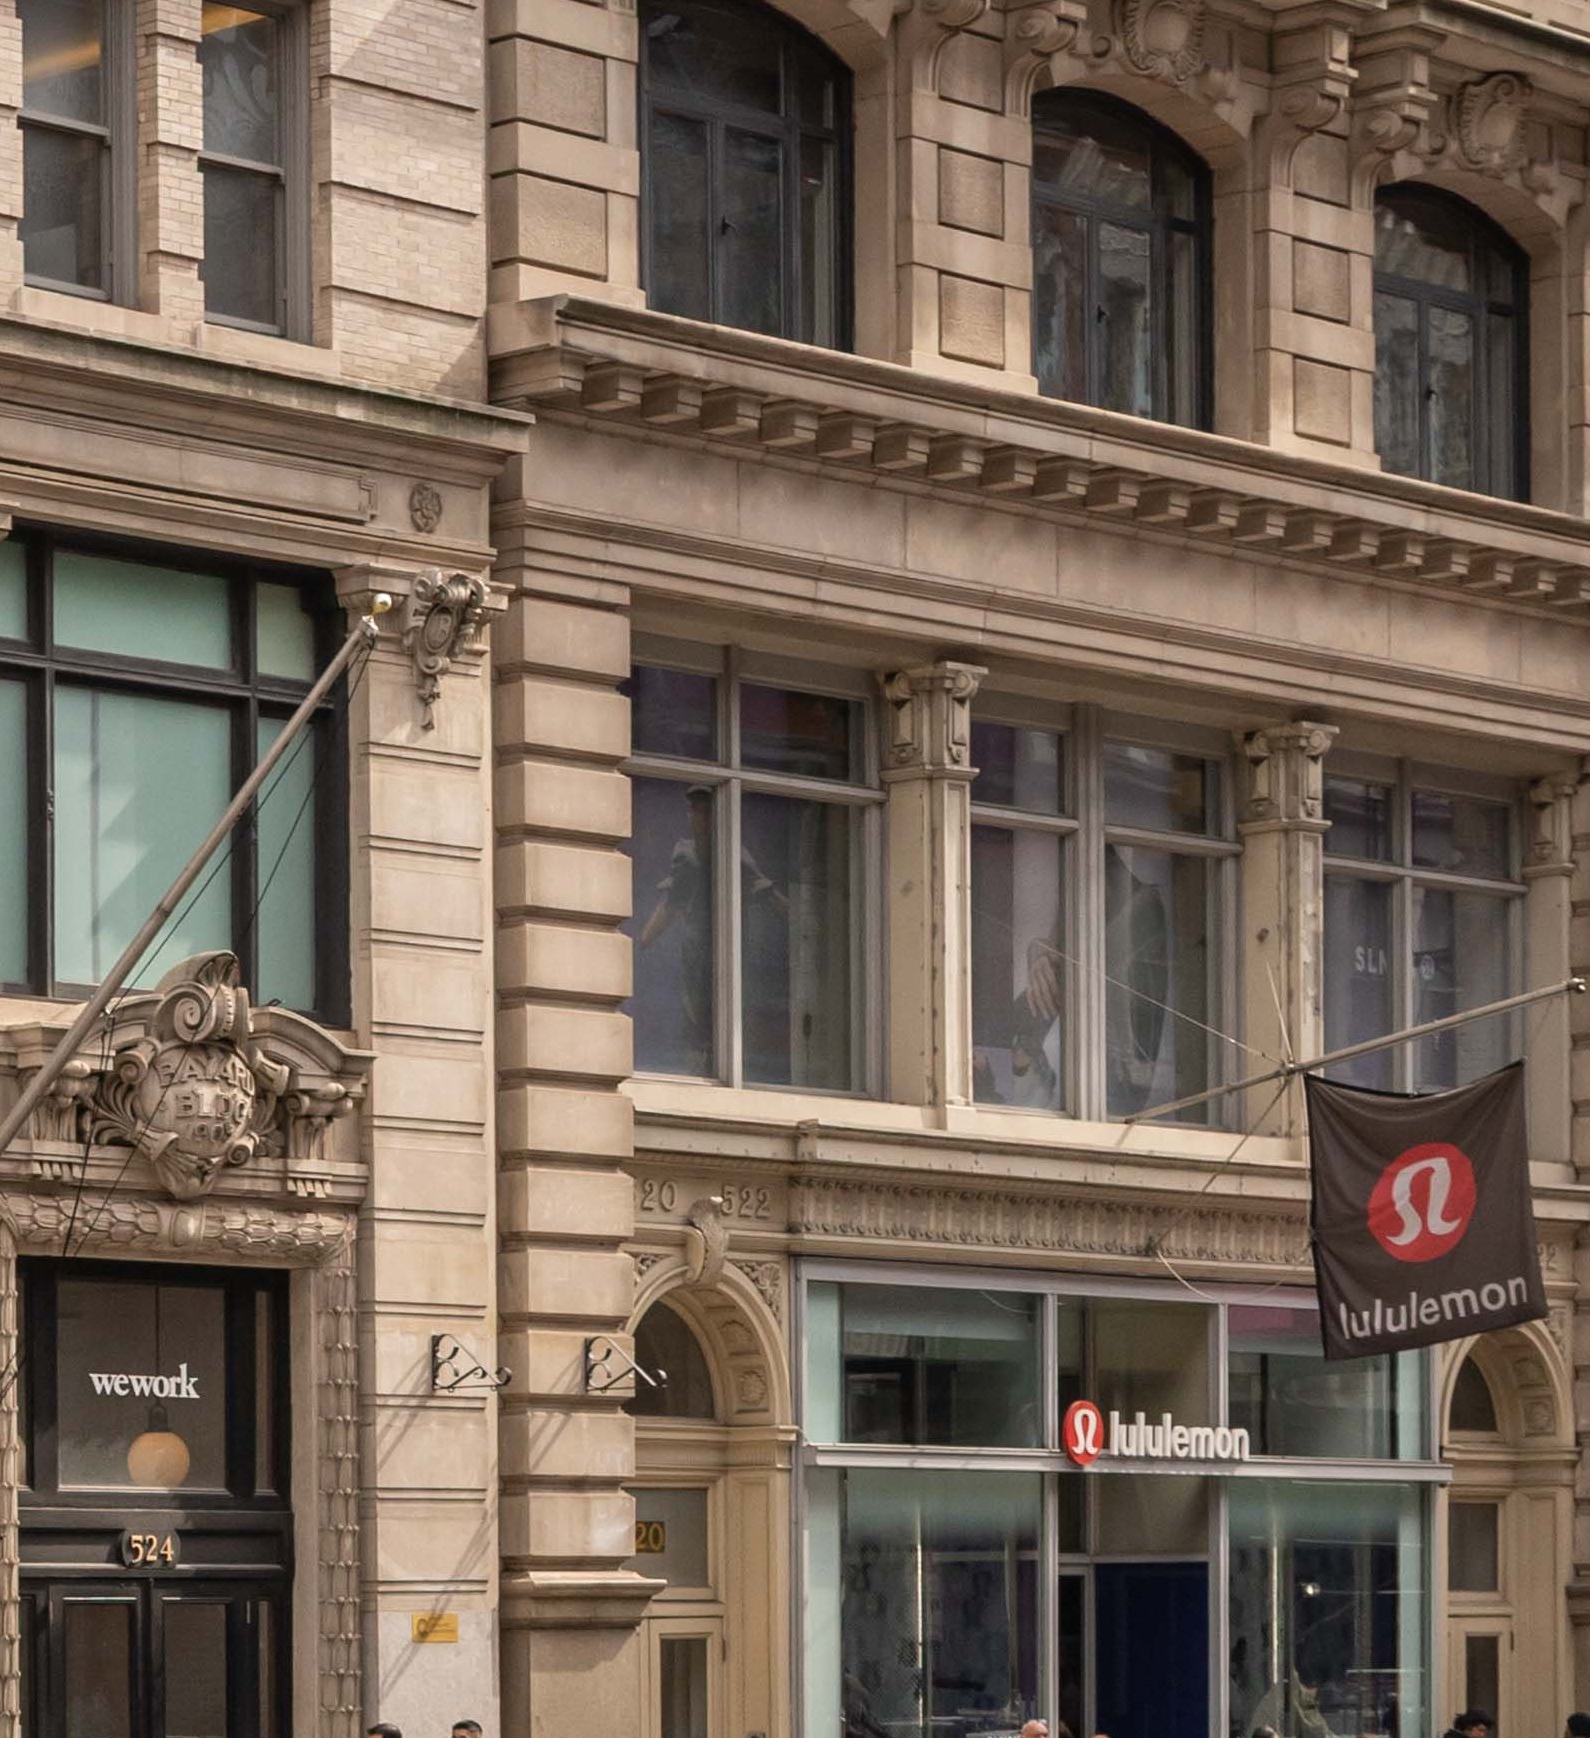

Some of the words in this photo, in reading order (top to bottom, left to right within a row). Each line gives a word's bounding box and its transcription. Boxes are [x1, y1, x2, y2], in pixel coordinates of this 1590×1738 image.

[640, 1179, 677, 1212] 20
[721, 1184, 770, 1219] 522
[1339, 1276, 1528, 1341] lululemon
[89, 1363, 200, 1399] wework
[1109, 1410, 1250, 1460] lululemon
[131, 1534, 175, 1563] 524
[635, 1522, 664, 1551] 20
